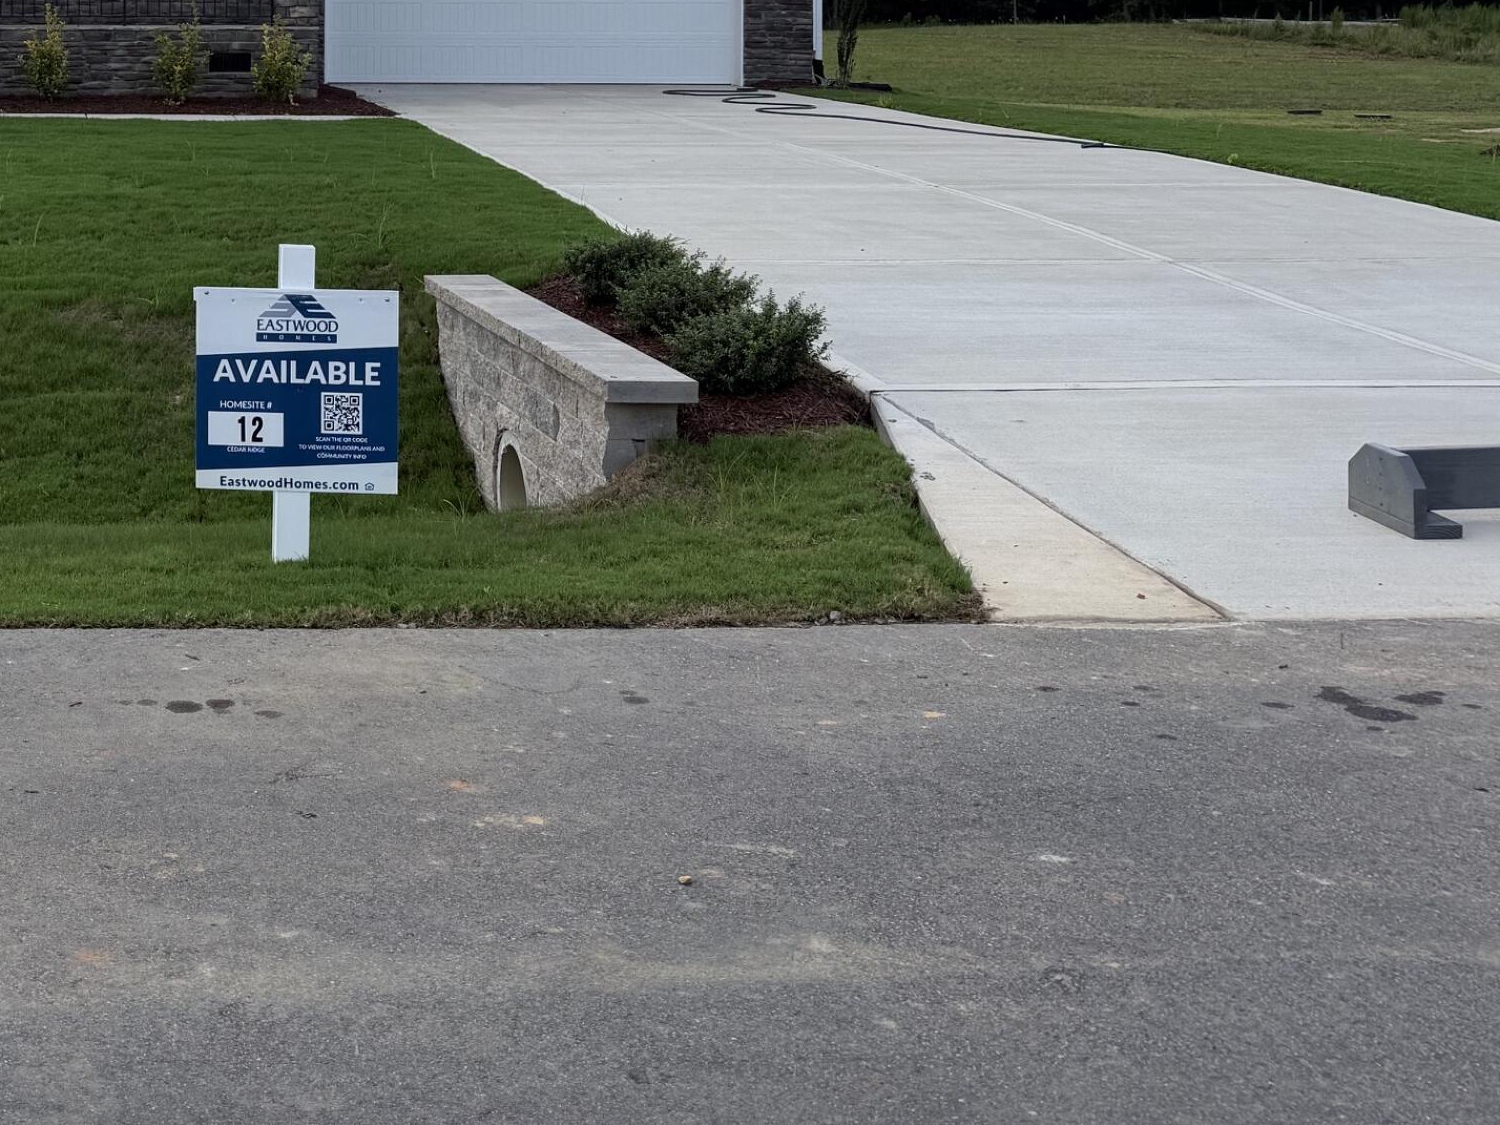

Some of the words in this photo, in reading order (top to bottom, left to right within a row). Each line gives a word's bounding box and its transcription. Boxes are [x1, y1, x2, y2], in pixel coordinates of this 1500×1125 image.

[257, 319, 339, 333] EASTWOOD
[213, 359, 381, 386] AVAILABLE
[220, 400, 266, 410] HOMESITE
[237, 415, 264, 443] 12
[220, 475, 359, 491] EastwoodHomes.com
